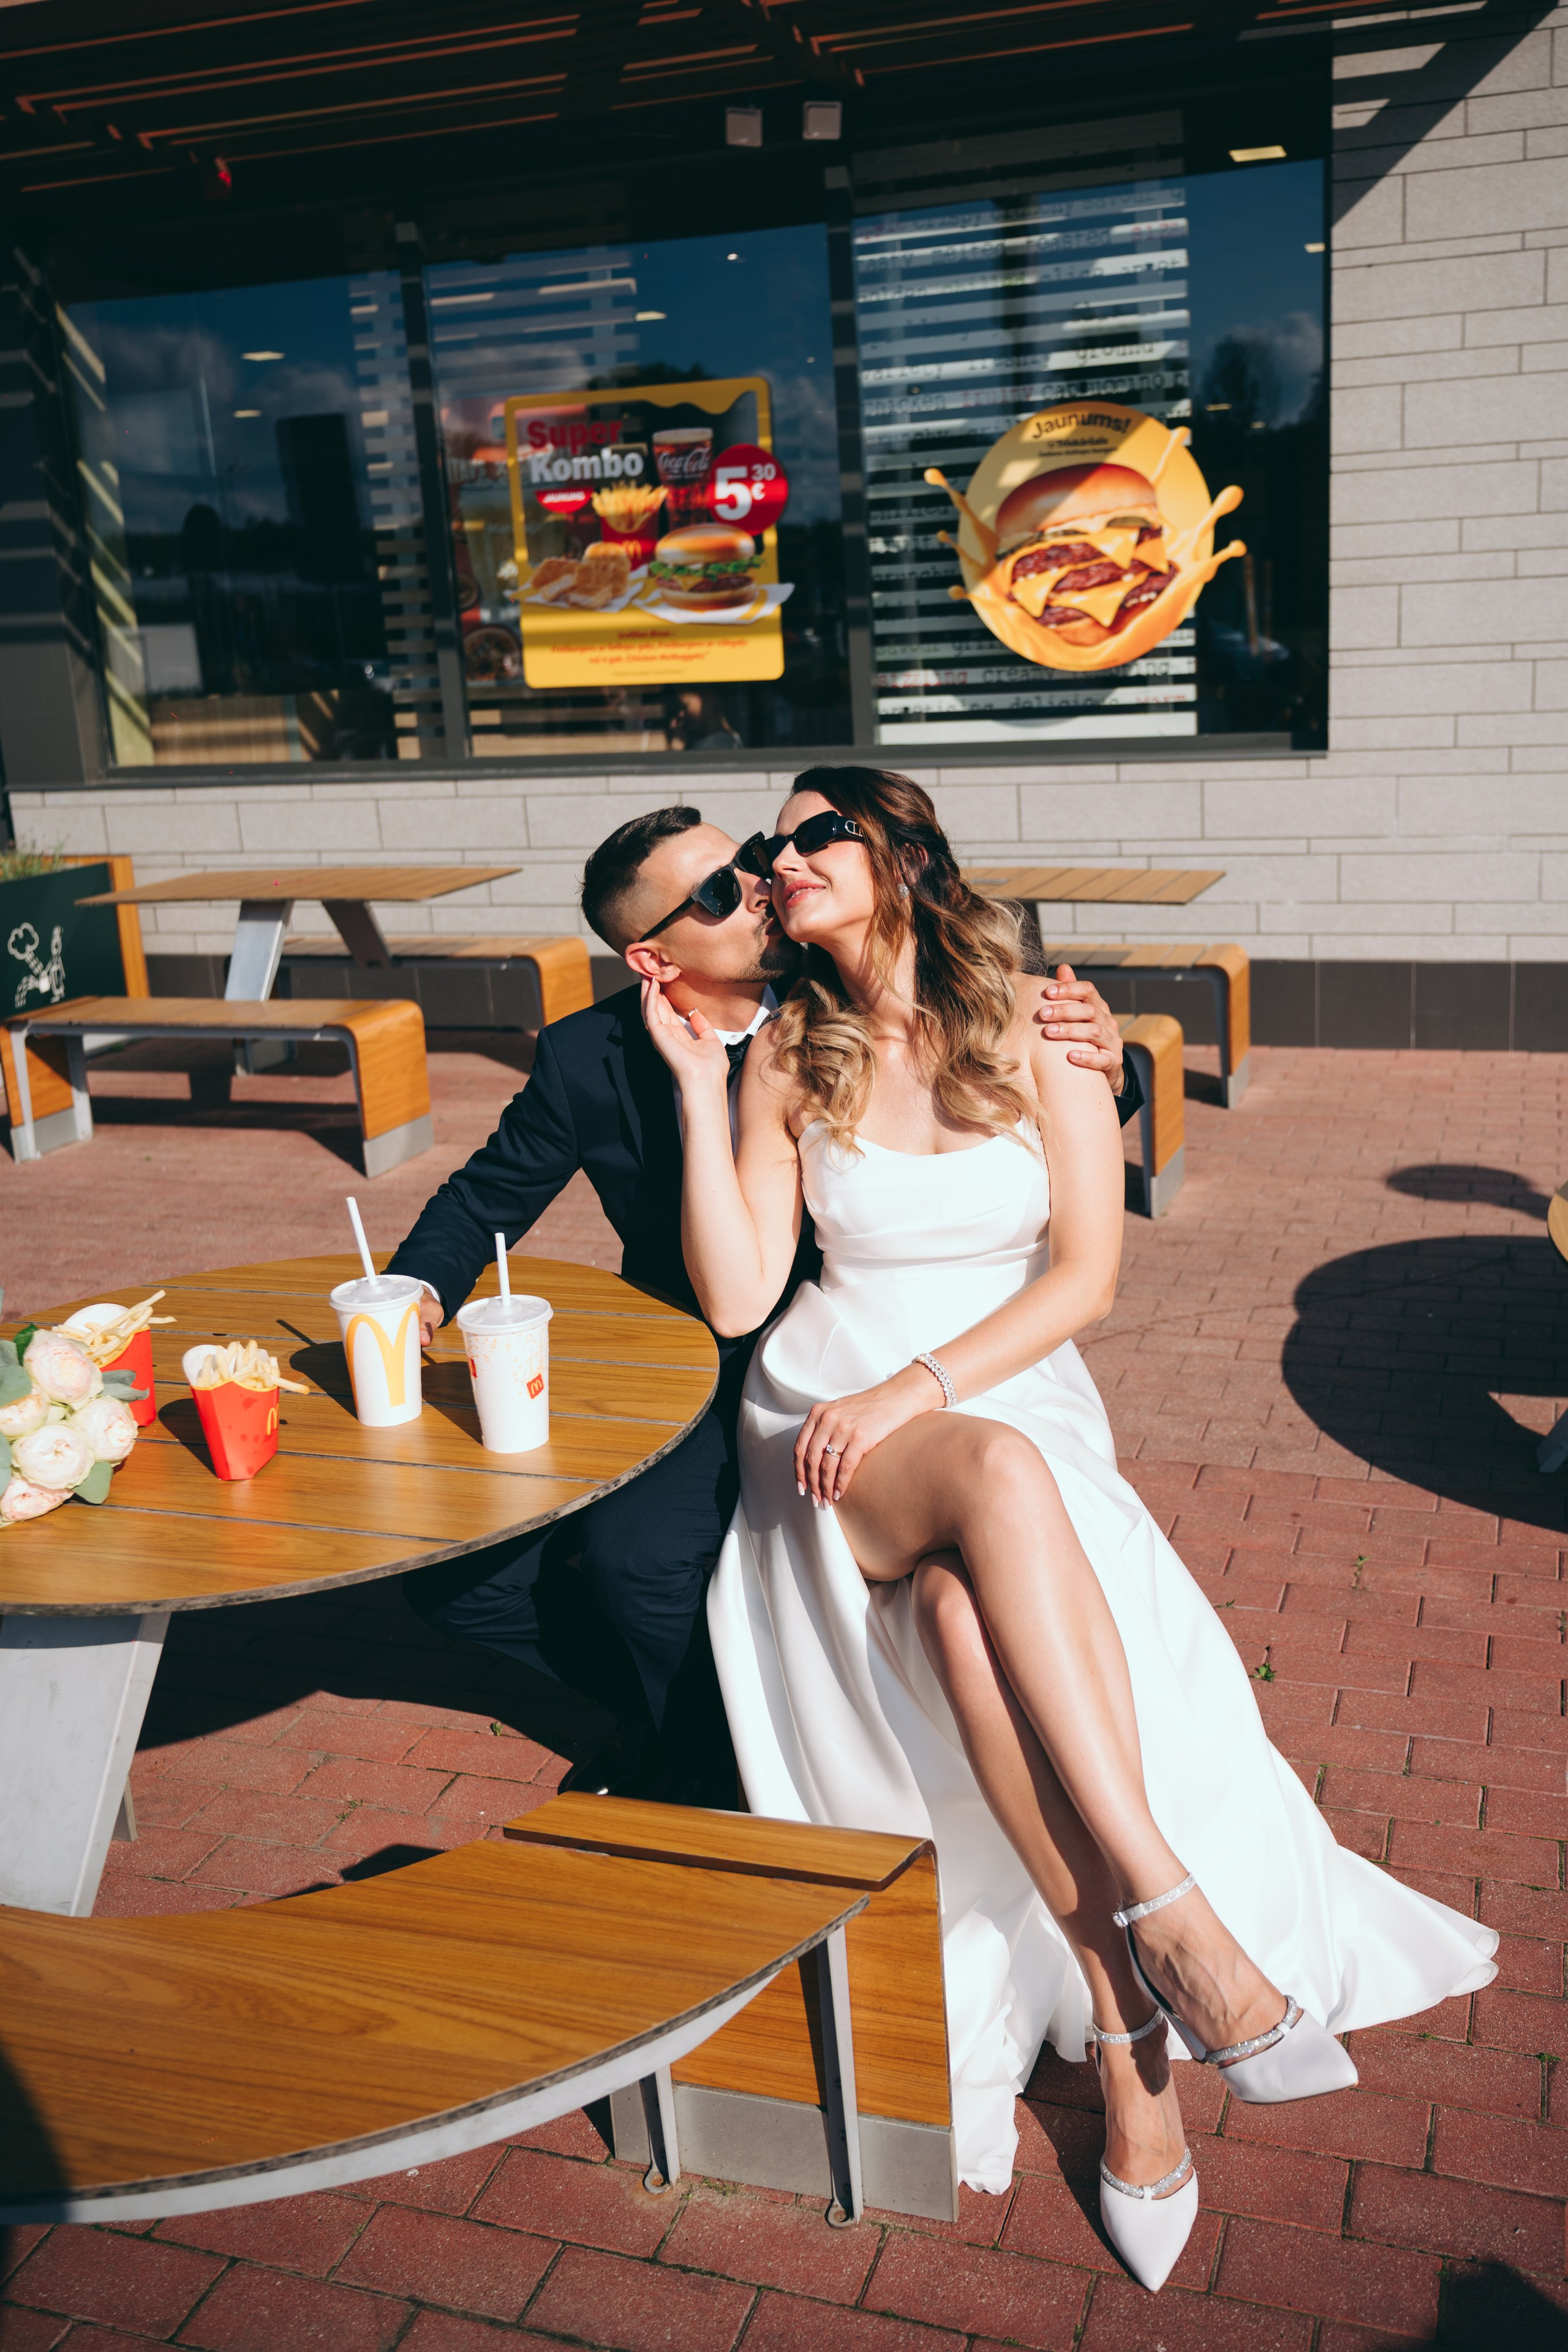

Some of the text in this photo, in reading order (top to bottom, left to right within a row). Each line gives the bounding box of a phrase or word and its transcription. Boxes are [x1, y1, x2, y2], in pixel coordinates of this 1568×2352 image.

[527, 420, 622, 456] Super
[1033, 412, 1131, 439] Jaunums!
[531, 447, 644, 484] Kombo
[714, 463, 777, 521] 5 30
[751, 481, 766, 501] €
